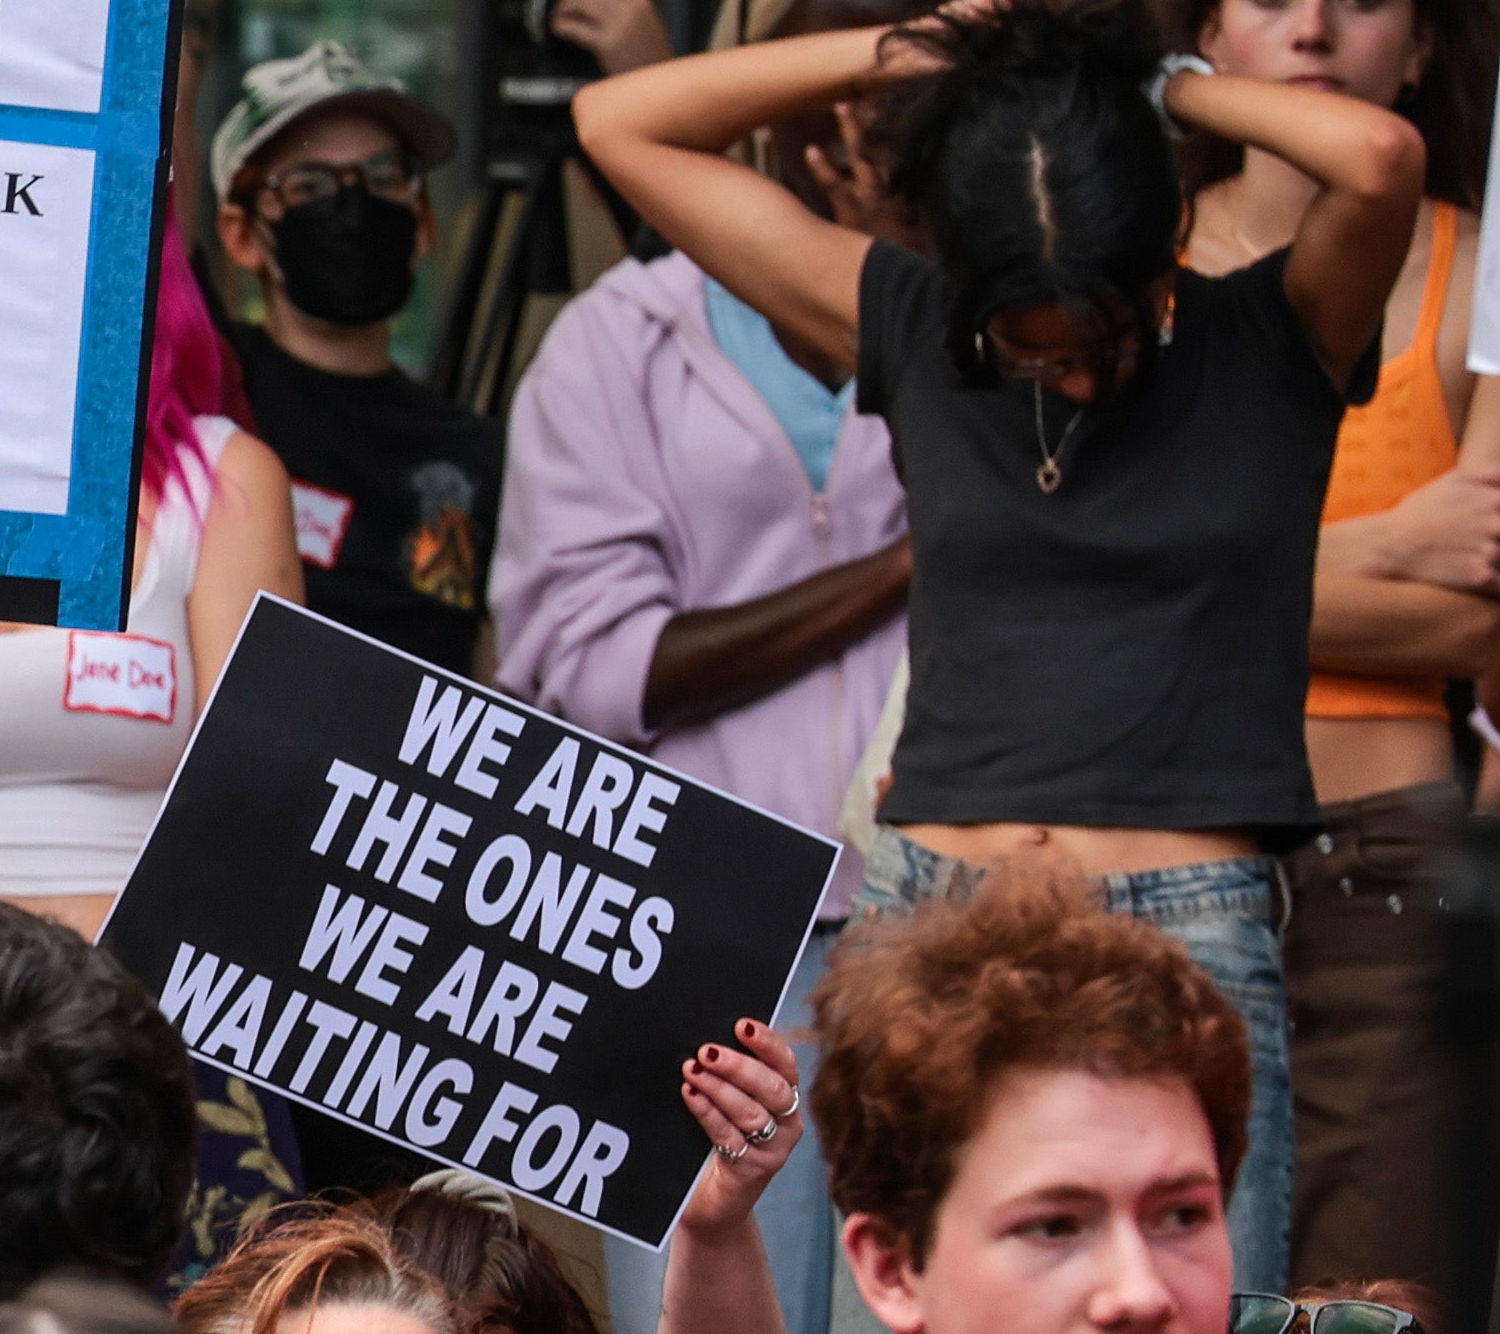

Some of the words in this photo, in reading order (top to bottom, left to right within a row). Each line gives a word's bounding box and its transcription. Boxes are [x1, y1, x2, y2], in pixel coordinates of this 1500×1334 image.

[309, 758, 473, 903] THE
[463, 833, 676, 991] ONES
[398, 674, 527, 800] WE
[514, 735, 682, 868] ARE
[157, 941, 475, 1149] WAITING
[461, 1077, 631, 1219] FOR
[297, 882, 431, 1008] WE
[413, 946, 590, 1075] ARE
